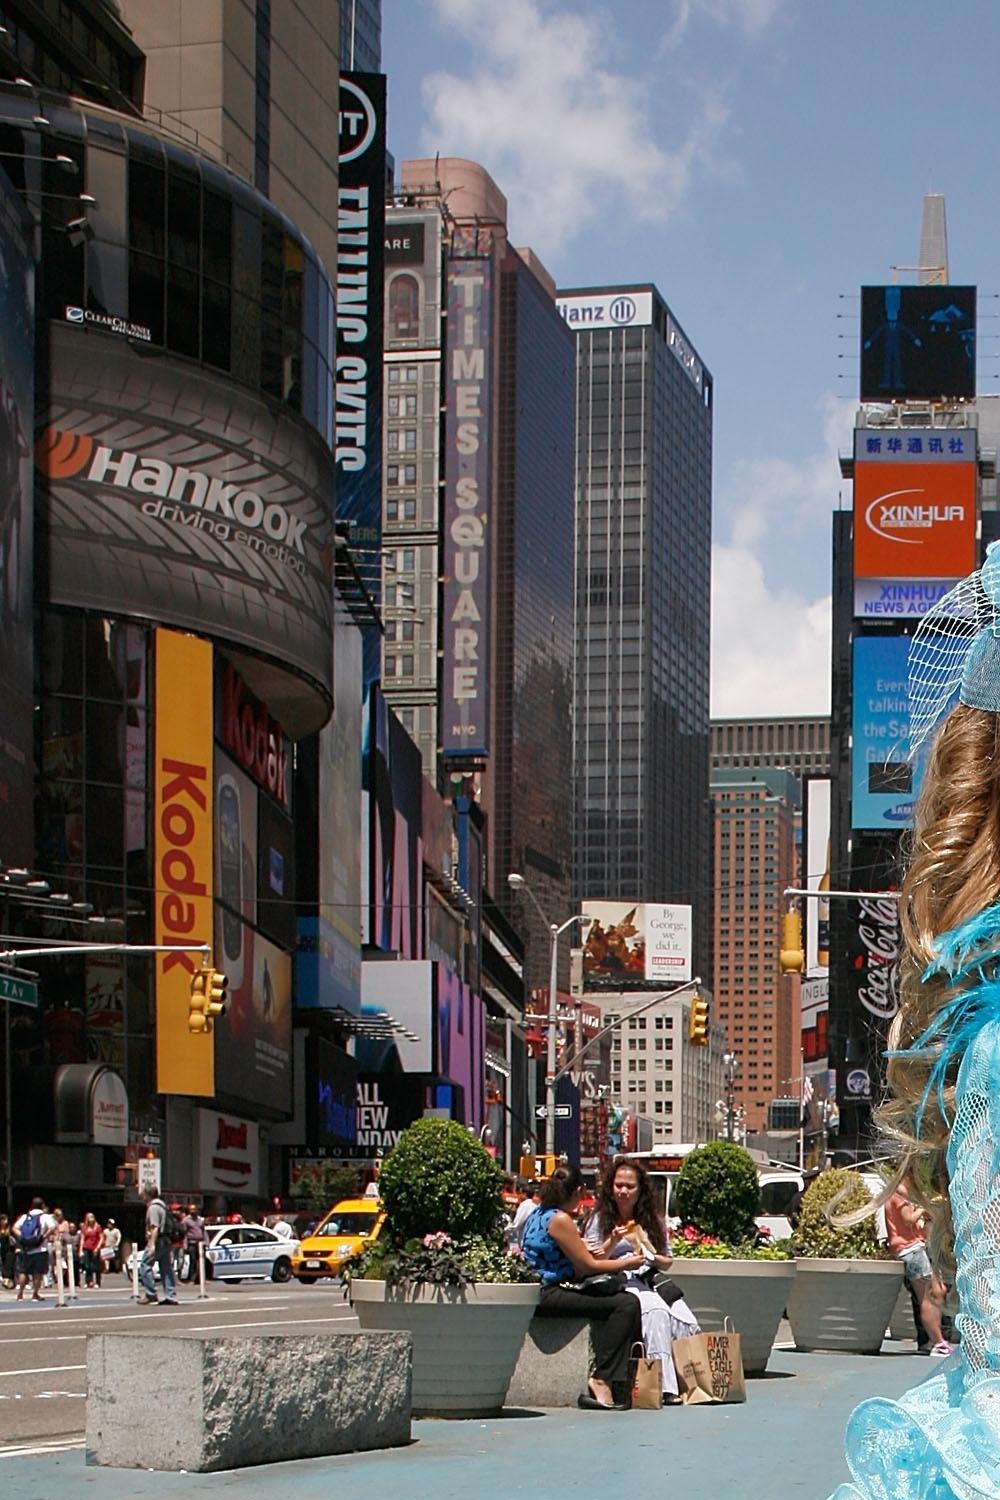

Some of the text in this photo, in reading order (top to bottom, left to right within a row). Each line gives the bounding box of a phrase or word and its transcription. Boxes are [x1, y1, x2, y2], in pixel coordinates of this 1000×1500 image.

[866, 437, 964, 454] 新华通讯社
[450, 276, 485, 699] TIMES SQUARE
[880, 505, 965, 521] XINHUA
[141, 500, 307, 575] driving emotion
[880, 585, 949, 601] XINHUA
[864, 602, 904, 613] NEWS
[223, 660, 288, 806] Kodak
[452, 724, 477, 737] NYC
[863, 722, 886, 737] the
[161, 757, 208, 975] Kodak
[663, 909, 675, 922] By
[650, 919, 687, 930] George,
[662, 931, 676, 940] we
[655, 941, 670, 951] did
[2, 980, 9, 994] 7
[356, 1083, 384, 1106] ALL
[289, 1146, 384, 1157] MARQUIS
[708, 1348, 729, 1361] CAN
[709, 1360, 733, 1373] EAGLE
